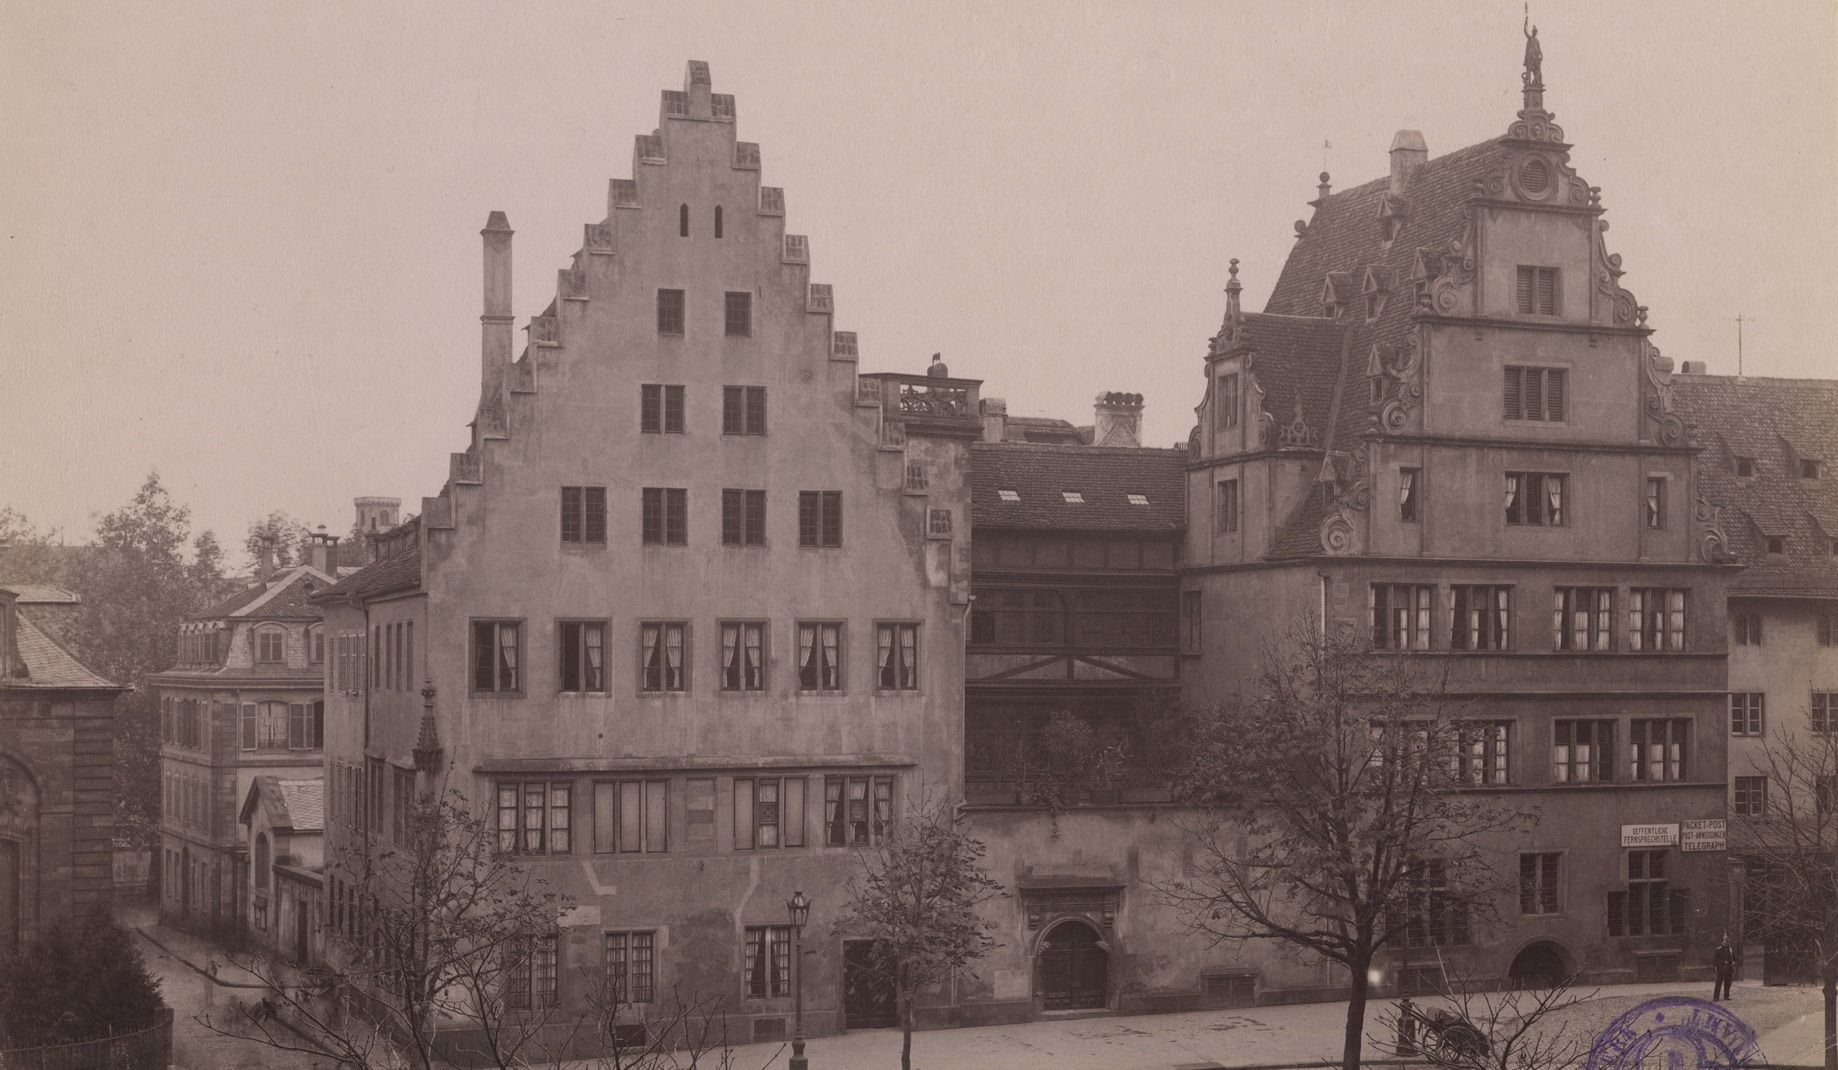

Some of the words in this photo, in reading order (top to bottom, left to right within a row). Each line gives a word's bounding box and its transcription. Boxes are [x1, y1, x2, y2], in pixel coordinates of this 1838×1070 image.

[1682, 820, 1726, 830] PACKET-POST
[1632, 827, 1669, 835] OEFFENTLICHE
[1681, 831, 1726, 840] POST-ANWEISUNGEN
[1623, 835, 1677, 844] FERNSPRECHSTELLE
[1684, 842, 1725, 851] TELEGRAPH
